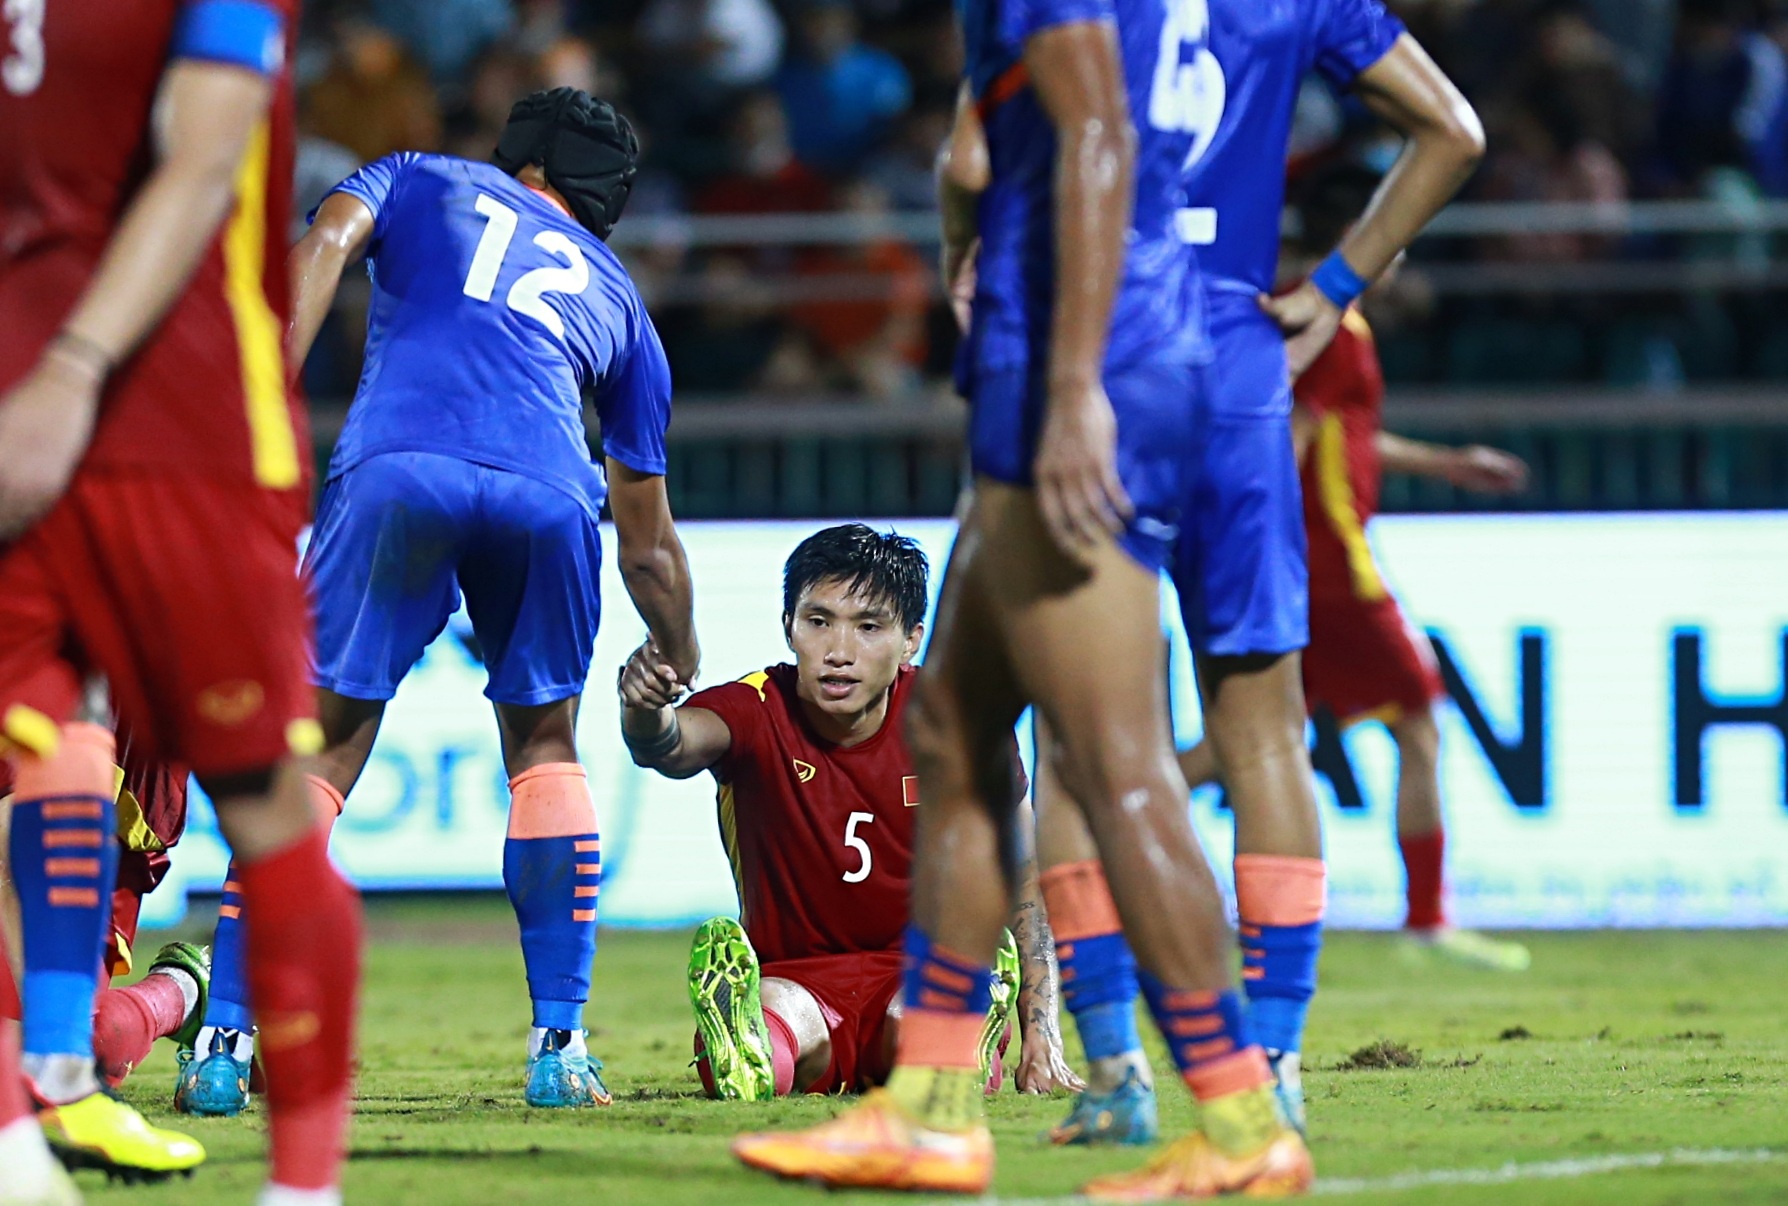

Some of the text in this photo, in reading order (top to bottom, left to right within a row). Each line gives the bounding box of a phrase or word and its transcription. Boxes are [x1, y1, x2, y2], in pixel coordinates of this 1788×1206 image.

[2, 0, 46, 96] 3
[463, 192, 590, 340] 12
[842, 811, 875, 883] 5
